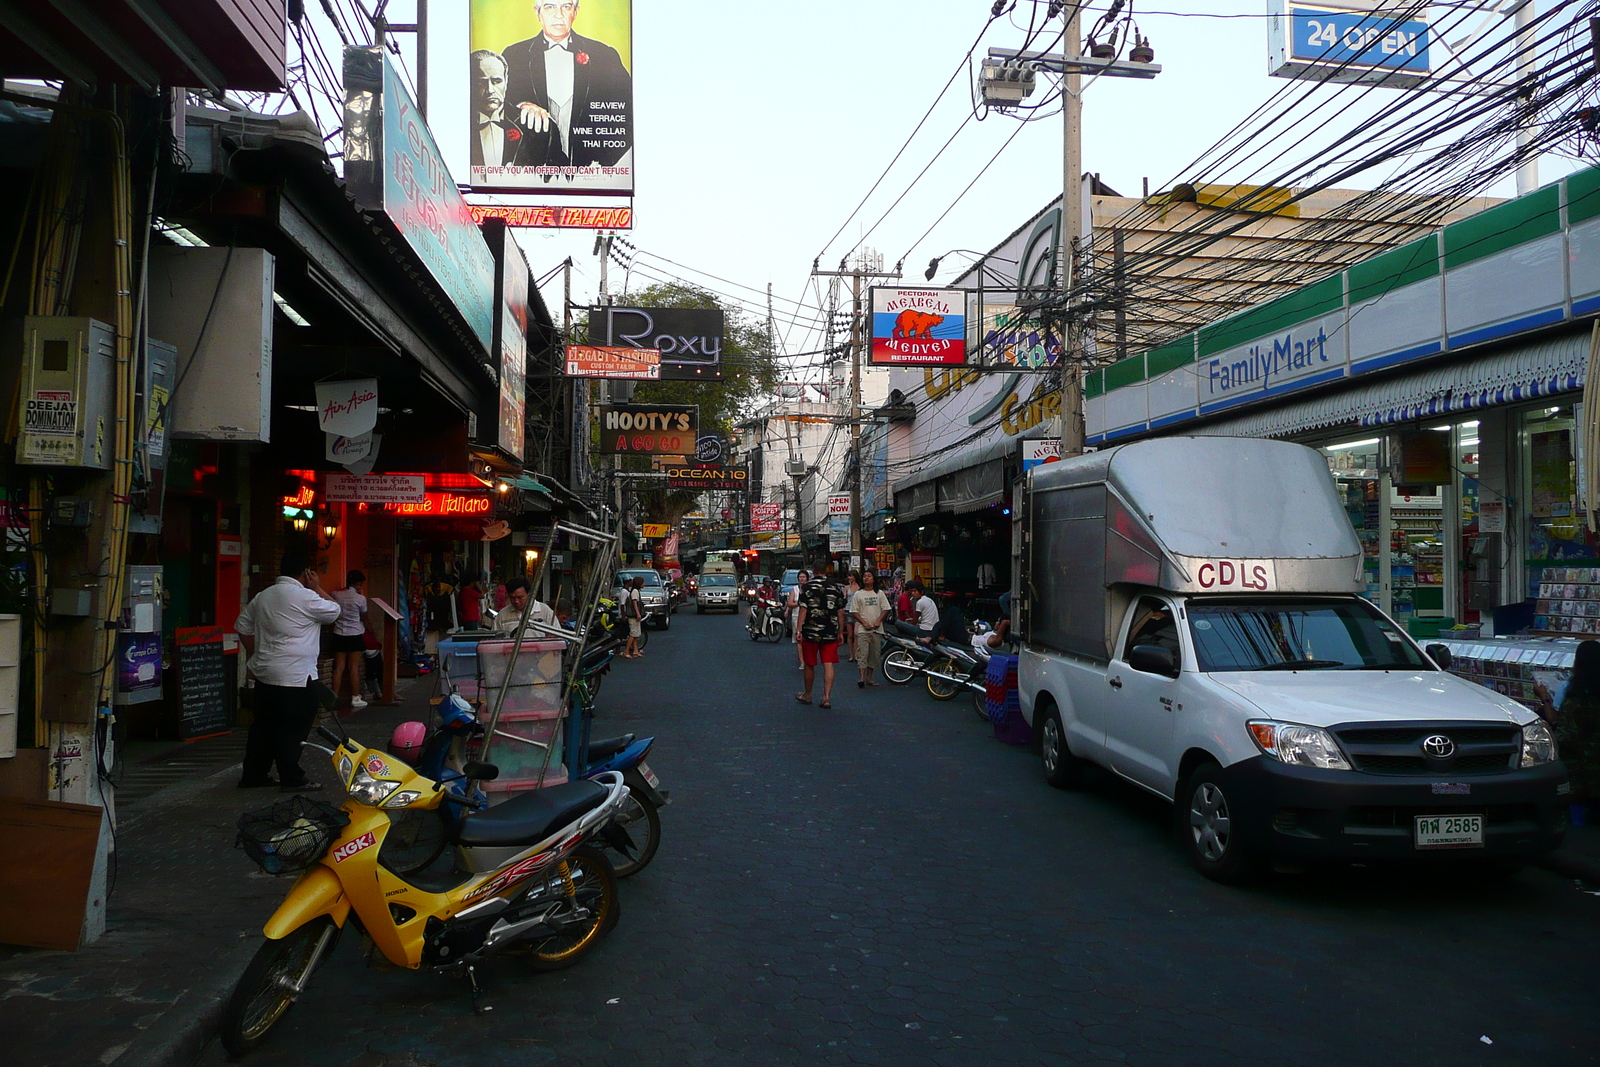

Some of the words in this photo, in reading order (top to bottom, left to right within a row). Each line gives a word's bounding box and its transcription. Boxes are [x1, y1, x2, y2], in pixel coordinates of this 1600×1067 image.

[1307, 20, 1337, 47] 24
[1343, 26, 1416, 56] OPEN
[590, 101, 626, 110] SEAVIEW
[589, 114, 626, 122] TERRACE
[573, 127, 593, 135] WINE
[595, 127, 626, 135] CELLAR
[393, 79, 449, 209] Yenjit
[582, 140, 601, 148] THAI
[603, 140, 626, 148] FOOD
[473, 166, 485, 174] WE
[487, 166, 504, 175] GIVE
[506, 166, 521, 175] YOU
[523, 166, 534, 175] AN
[536, 166, 559, 175] OFFER
[561, 166, 577, 175] YOU
[578, 166, 599, 175] CAN'T
[602, 166, 630, 175] REFUSE
[561, 207, 631, 227] ITALIANO
[886, 297, 950, 314] МЕДВЕДЬ
[885, 337, 951, 353] MEDVED
[621, 353, 659, 364] FASHION
[1209, 326, 1328, 393] FamilyMart
[27, 400, 77, 412] DEEJAY
[25, 410, 76, 427] DOMINATION
[606, 411, 690, 431] HOOTY'S
[616, 435, 627, 450] A
[632, 435, 655, 450] GO
[659, 436, 681, 450] GO
[667, 468, 725, 479] OCEAN
[729, 470, 746, 480] 10
[713, 481, 746, 489] STREET
[1198, 561, 1268, 591] CDLS
[1445, 818, 1479, 833] 2585
[334, 836, 368, 862] NGK
[385, 887, 408, 897] HONDA
